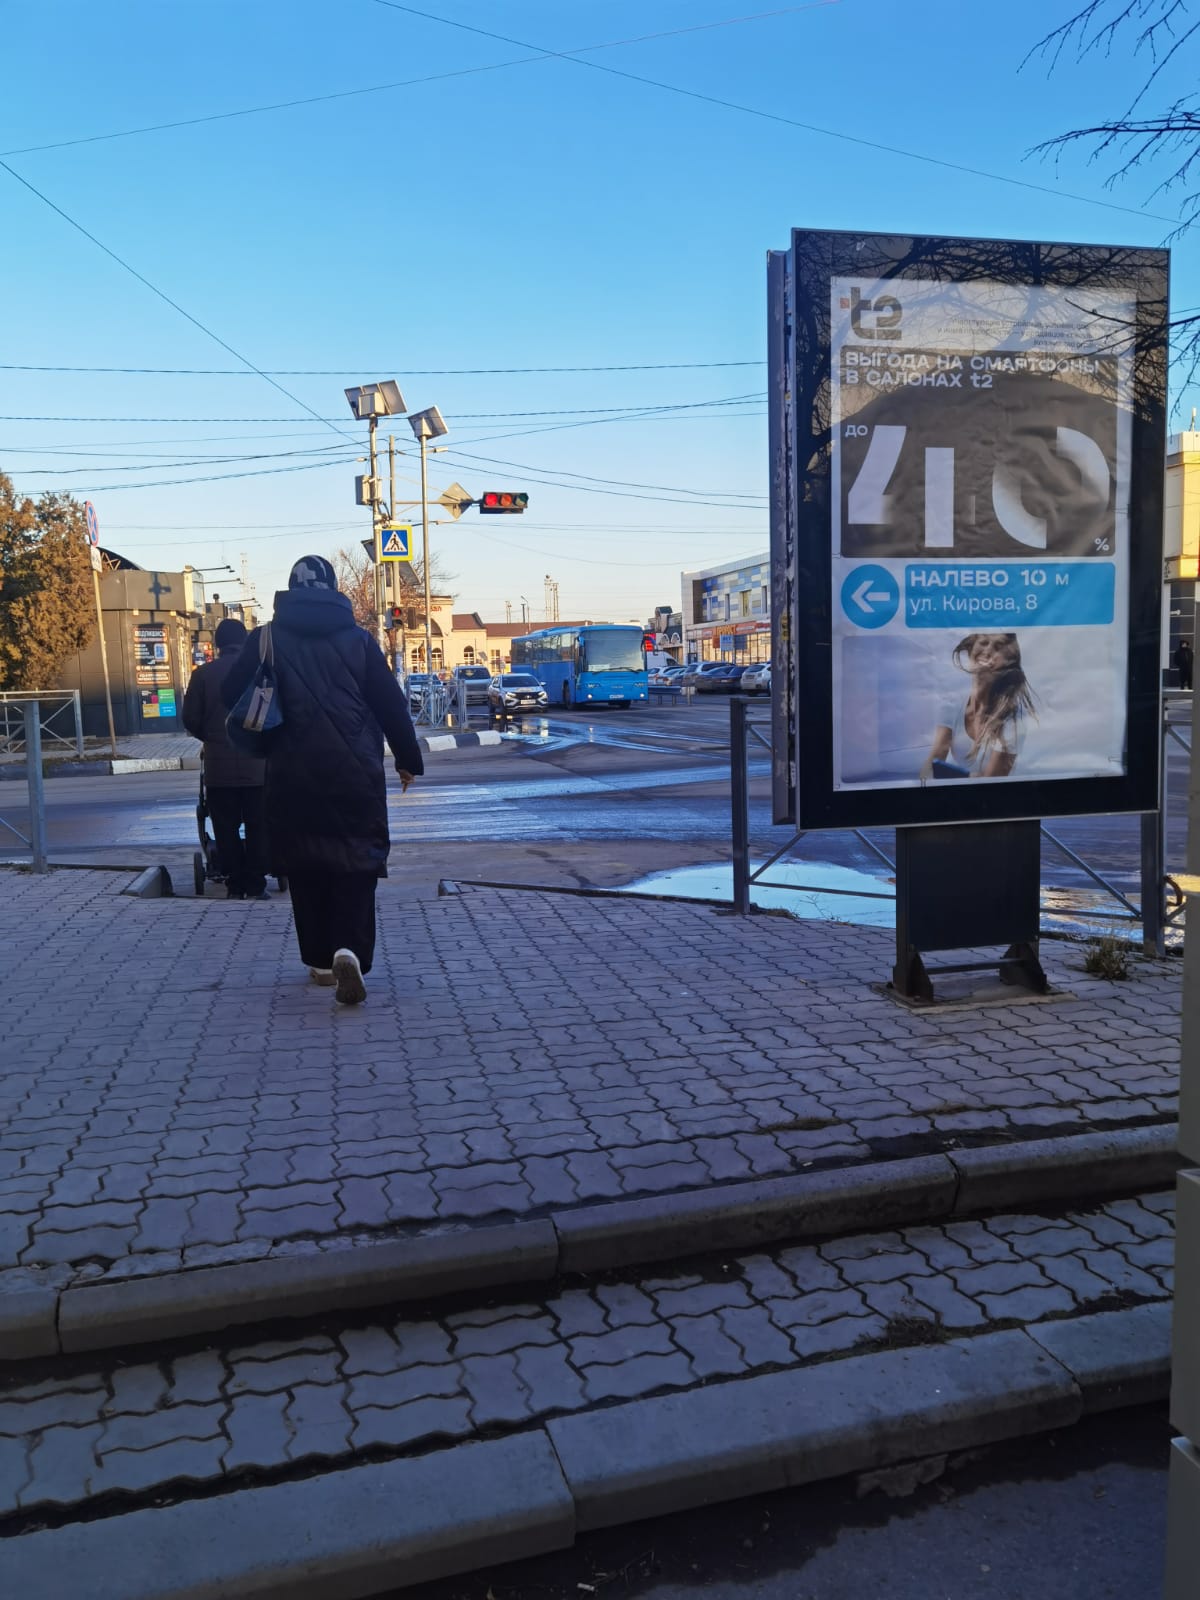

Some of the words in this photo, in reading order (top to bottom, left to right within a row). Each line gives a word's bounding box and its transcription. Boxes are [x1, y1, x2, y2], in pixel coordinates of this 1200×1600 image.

[850, 286, 903, 341] t2
[845, 351, 930, 369] ВЫГОДА
[937, 355, 963, 371] НА
[970, 356, 1099, 374] СМАРТФОНЫ
[846, 370, 859, 385] В
[866, 371, 962, 389] САЛОНАХ
[970, 373, 993, 389] t2
[910, 569, 1009, 588] НАЛЕВО
[1020, 569, 1047, 587] 10
[910, 598, 936, 615] ул.
[943, 596, 1020, 614] Кирова,
[1025, 594, 1038, 610] 8
